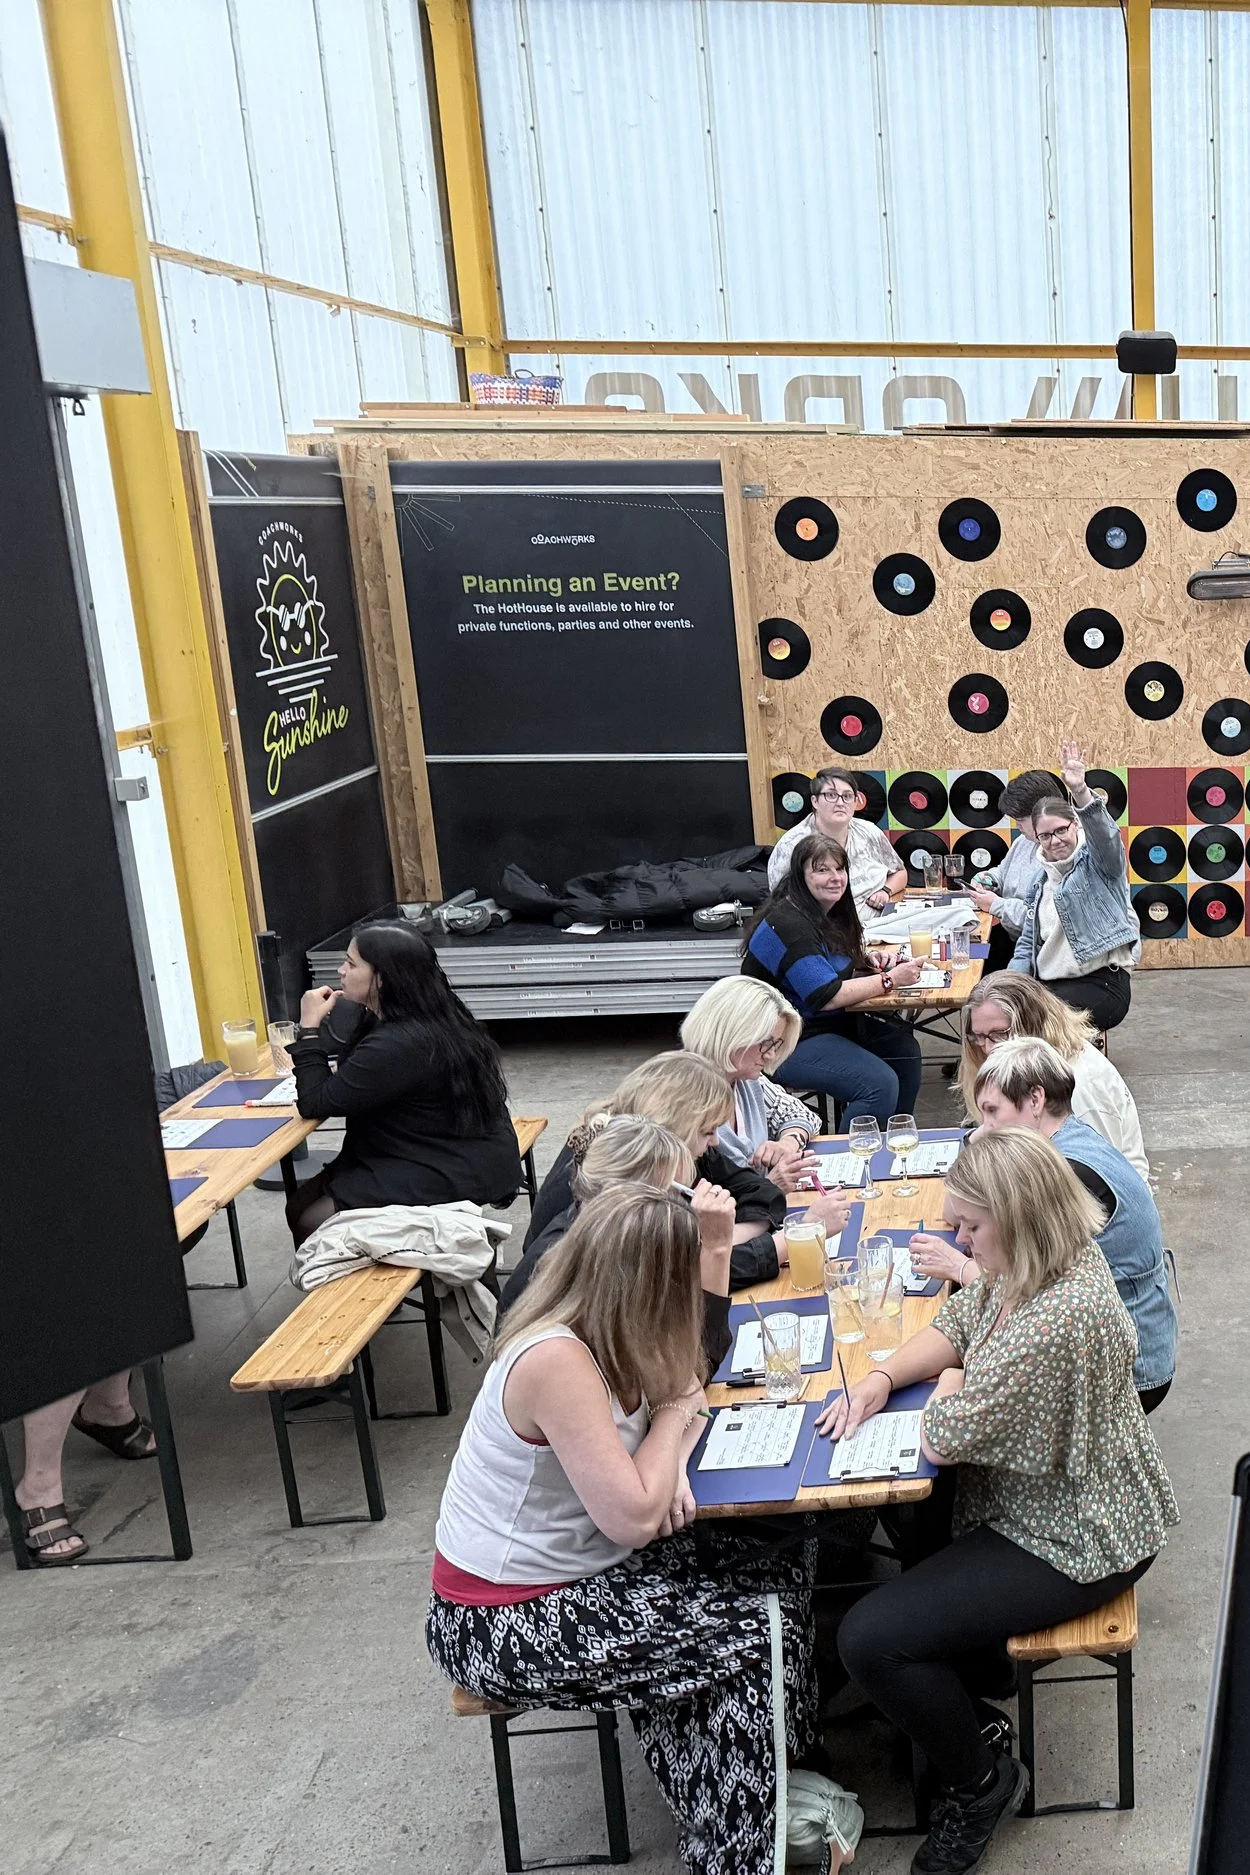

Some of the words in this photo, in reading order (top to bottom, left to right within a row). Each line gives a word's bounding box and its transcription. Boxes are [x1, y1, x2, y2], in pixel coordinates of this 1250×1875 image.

[462, 574, 562, 597] Planning
[568, 576, 596, 592] an
[603, 571, 680, 592] Event?
[473, 603, 495, 614] The
[497, 602, 553, 614] HotHouse
[555, 602, 566, 613] is
[568, 601, 618, 613] available
[620, 601, 632, 612] to
[634, 600, 656, 611] hire
[658, 600, 675, 611] for
[457, 621, 497, 635] private
[499, 620, 556, 633] functions,
[557, 619, 596, 632] parties
[598, 619, 620, 630] and
[622, 618, 652, 629] other
[654, 617, 695, 629] events.
[278, 706, 306, 728] HELLO
[263, 687, 349, 796] Sunshine
